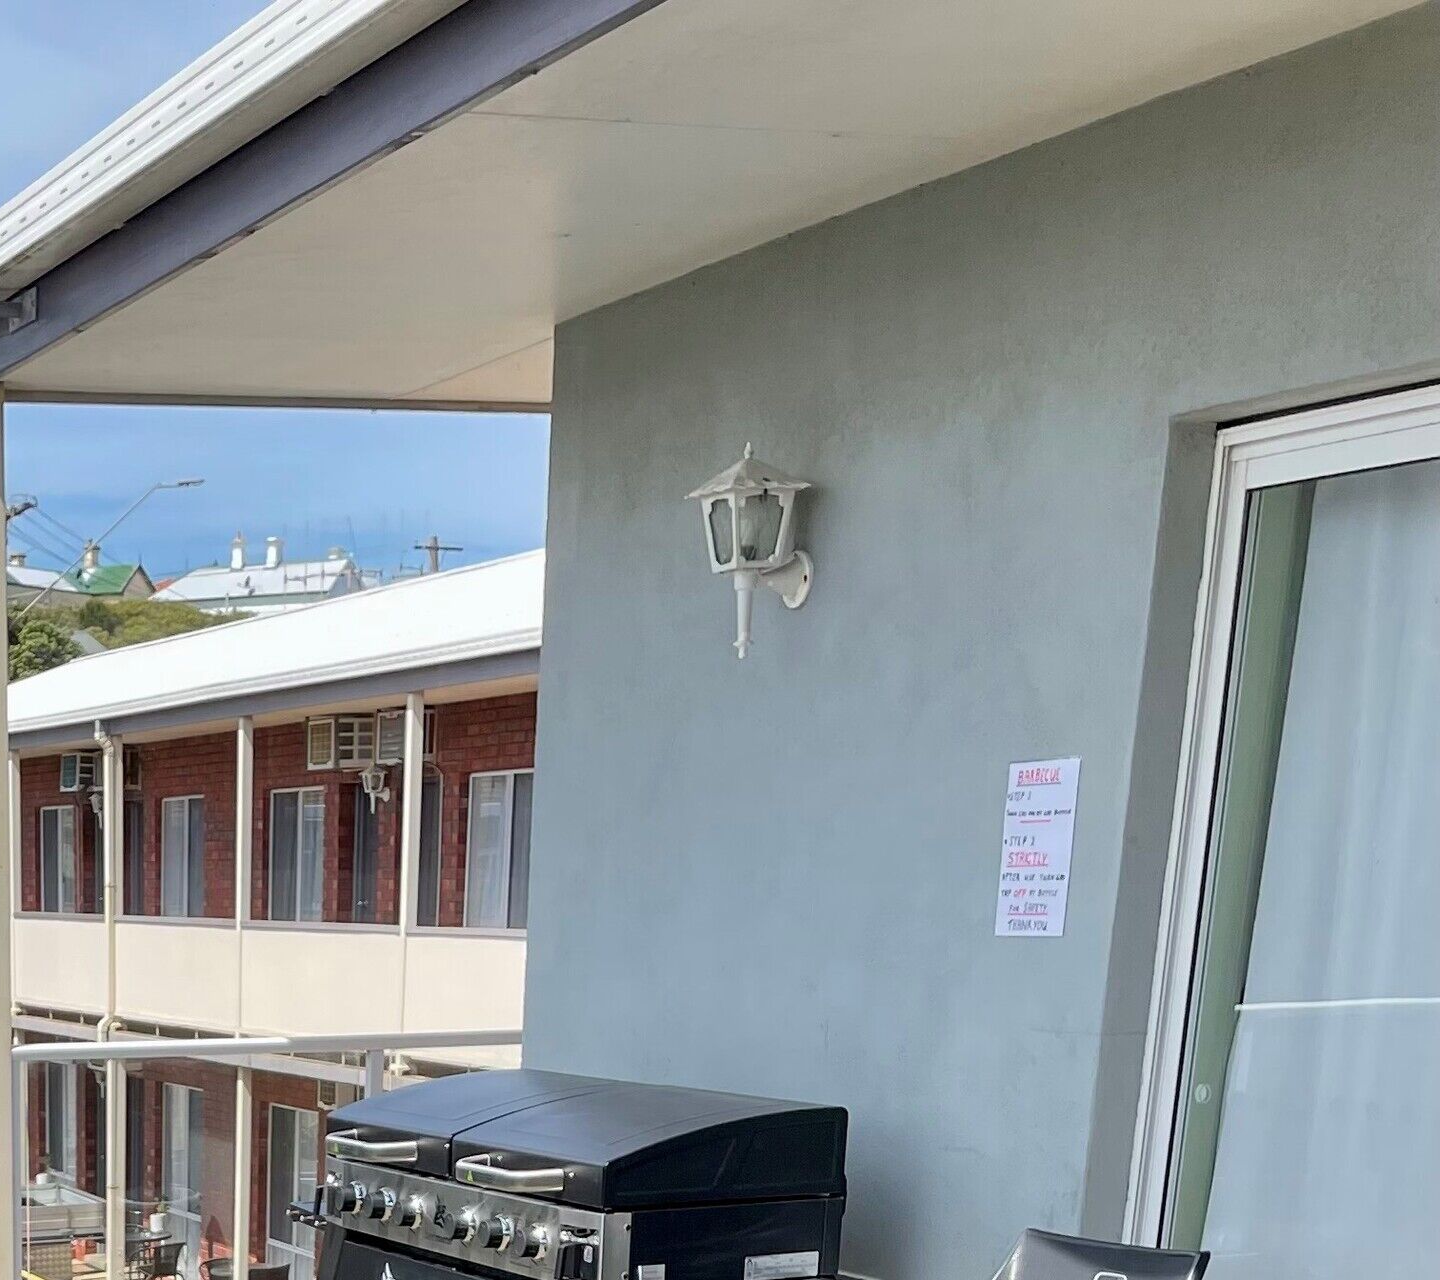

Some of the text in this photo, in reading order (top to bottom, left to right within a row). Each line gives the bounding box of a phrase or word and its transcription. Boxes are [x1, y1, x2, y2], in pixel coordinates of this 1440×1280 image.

[1017, 768, 1061, 785] BARBECUE
[1009, 835, 1027, 847] STEP
[1008, 851, 1048, 866] STRICTLY
